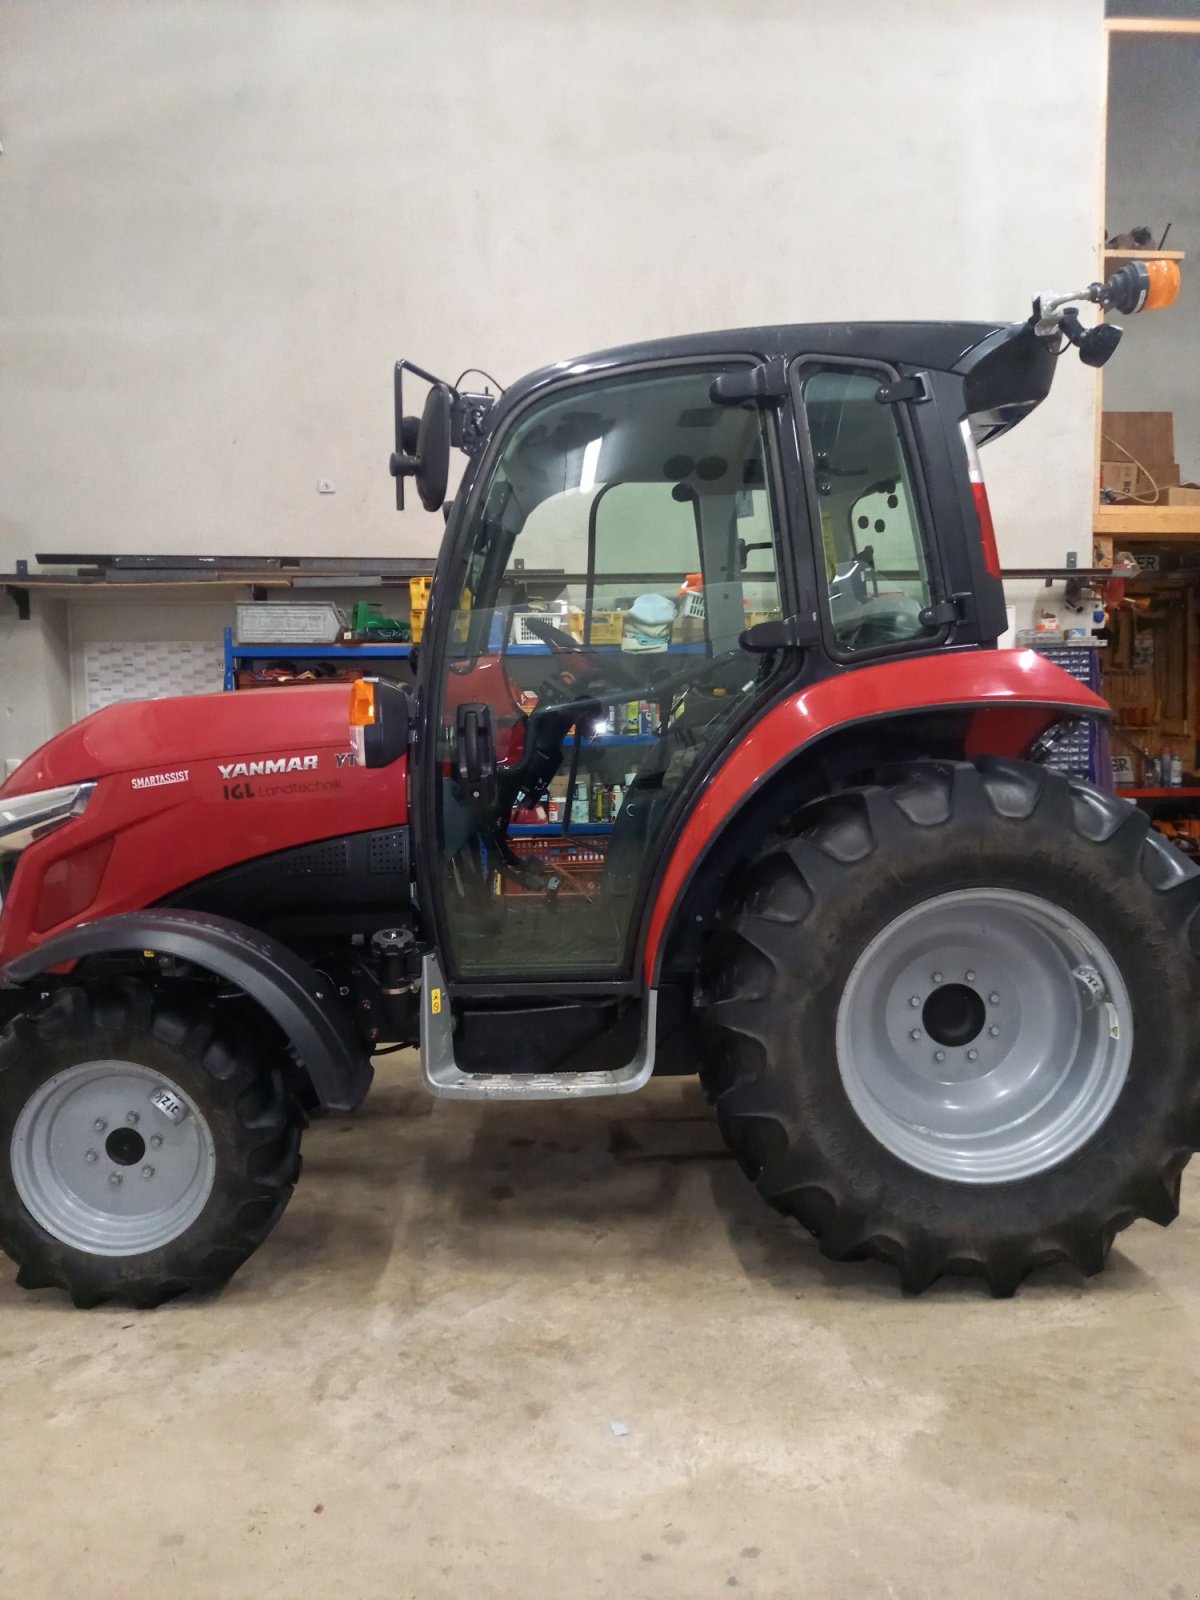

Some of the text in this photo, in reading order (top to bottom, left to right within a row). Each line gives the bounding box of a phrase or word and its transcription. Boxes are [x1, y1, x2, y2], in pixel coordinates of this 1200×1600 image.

[217, 755, 318, 779] YANMAR
[131, 770, 189, 789] SMARTASSIST
[223, 779, 343, 800] IGL Landtechnik
